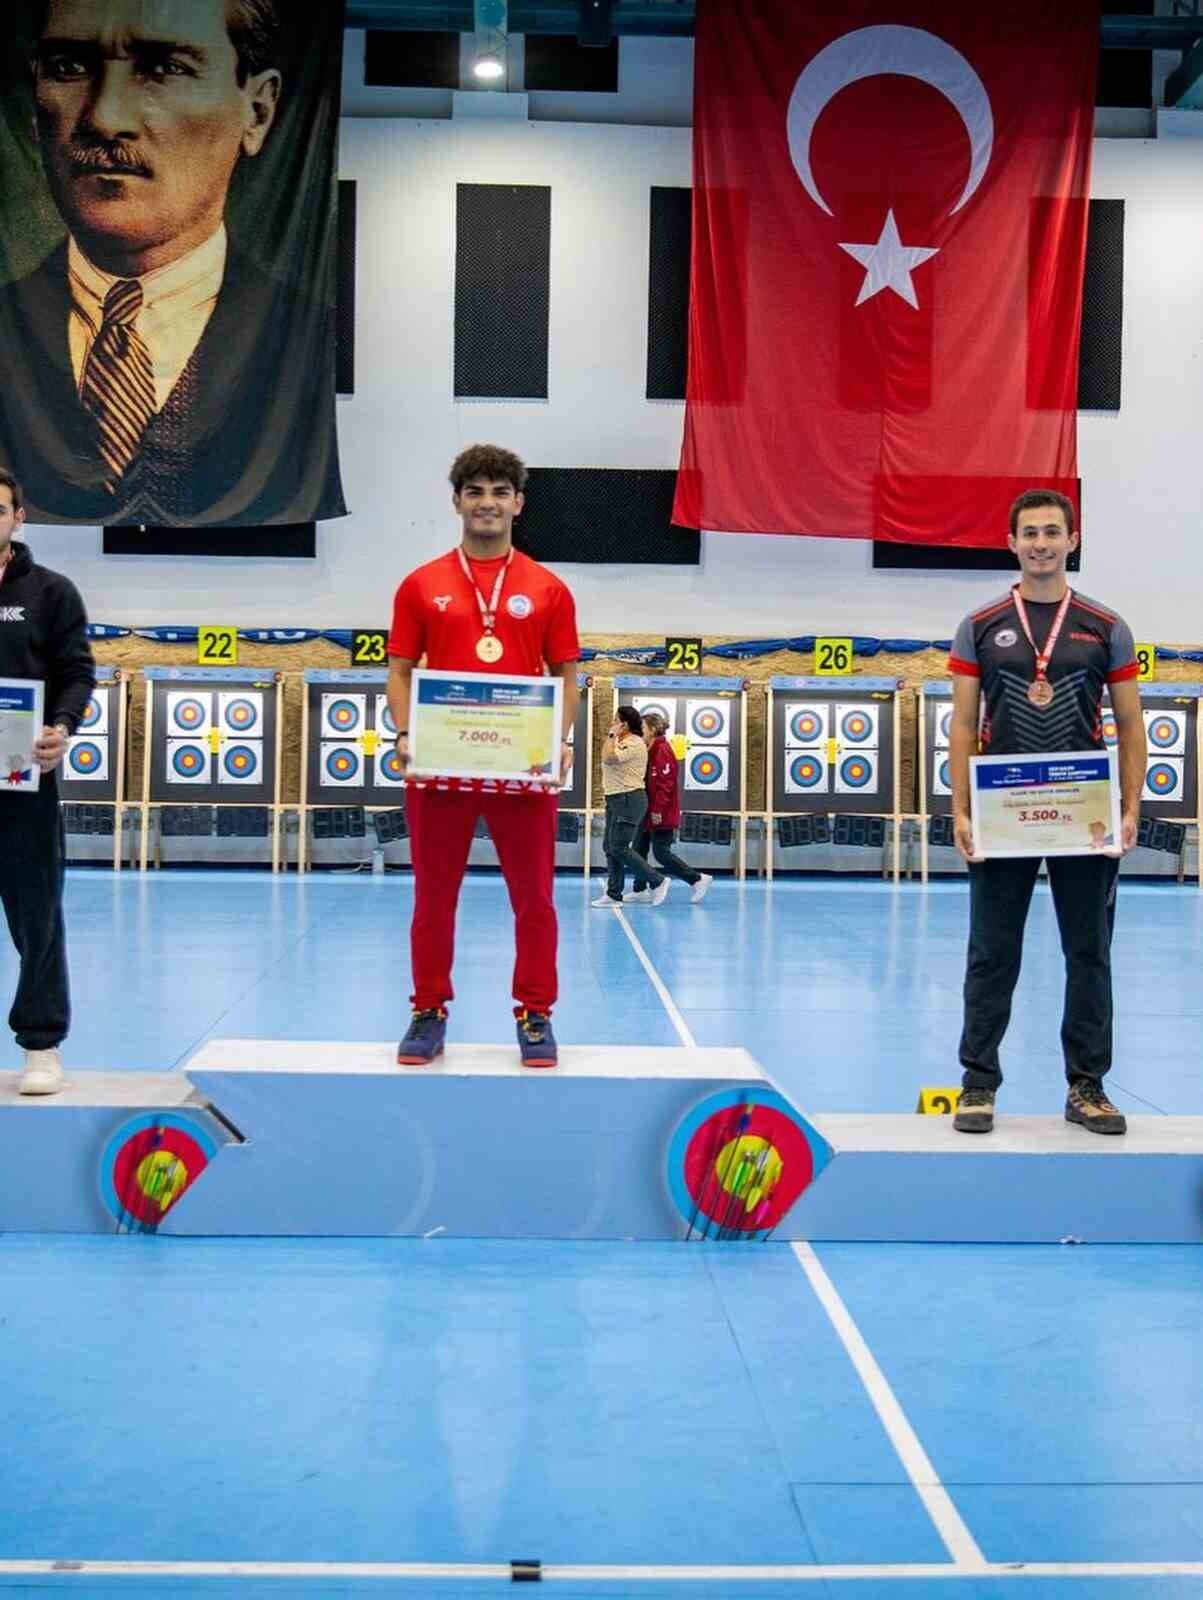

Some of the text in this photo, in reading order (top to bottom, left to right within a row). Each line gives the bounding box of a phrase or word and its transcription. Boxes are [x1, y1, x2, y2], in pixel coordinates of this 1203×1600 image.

[204, 632, 232, 658] 22
[355, 634, 385, 661] 23
[668, 642, 699, 670] 25
[819, 643, 848, 670] 26
[1137, 650, 1149, 675] 8
[1018, 809, 1058, 822] 3.500
